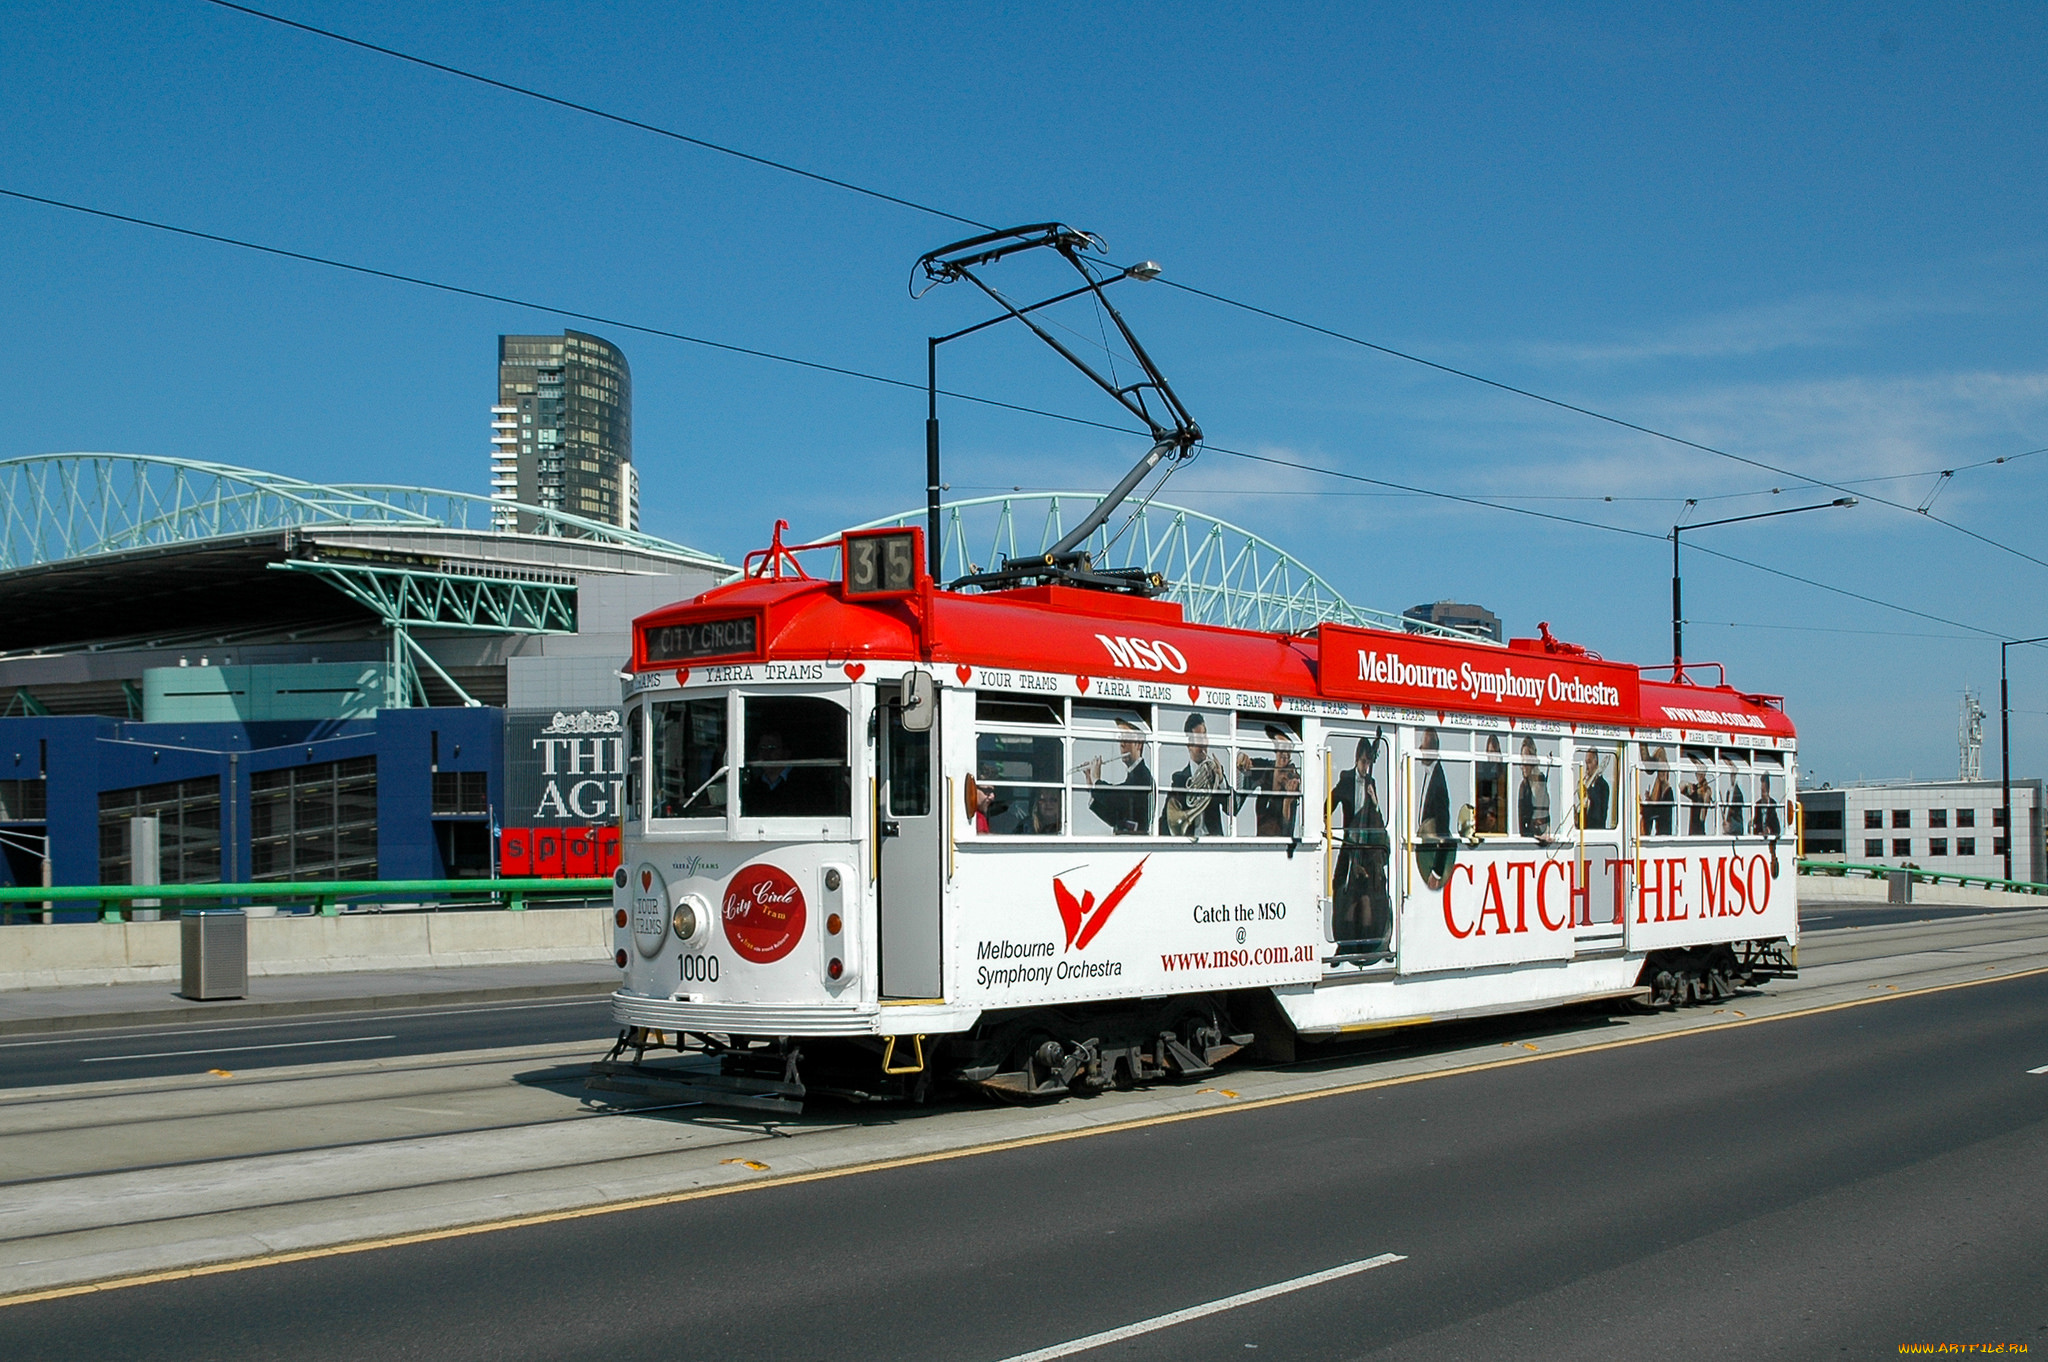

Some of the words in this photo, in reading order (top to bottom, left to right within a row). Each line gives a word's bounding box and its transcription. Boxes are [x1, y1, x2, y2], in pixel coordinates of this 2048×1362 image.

[853, 538, 912, 586] 35
[660, 627, 695, 653] CITY
[700, 618, 751, 648] CIRCLE
[1095, 633, 1188, 674] MSO
[705, 665, 754, 683] YARRA
[764, 664, 823, 681] TRAMS
[979, 671, 1012, 689] YOUR
[1019, 674, 1058, 692] TRAMS
[1357, 649, 1458, 690] Melbourne
[1460, 661, 1546, 706] Symphony
[1547, 673, 1620, 707] Orchestra
[1096, 680, 1132, 698] YARRA
[1138, 684, 1172, 701] TRAMS
[1205, 690, 1231, 706] YOUR
[1236, 693, 1267, 709] TRAMS
[1288, 698, 1317, 713] YARRA
[1322, 701, 1349, 716] TRAMS
[1375, 706, 1397, 720] YOUR
[1401, 708, 1426, 722] TRAMS
[1660, 706, 1767, 729] www.mso.com.au
[637, 898, 659, 915] YOUR
[722, 893, 751, 920] City
[752, 880, 798, 905] Circle
[1442, 858, 1593, 940] CATCH
[1604, 856, 1689, 925] THE
[1699, 853, 1772, 919] MSO
[762, 904, 786, 920] Tram
[1193, 904, 1232, 923] Catch
[1234, 903, 1254, 922] the
[1258, 902, 1287, 920] MSO
[635, 918, 663, 935] TRAMS
[1235, 926, 1247, 944] @
[976, 940, 1055, 961] Melbourne
[1161, 944, 1314, 972] www.mso.com.au
[677, 953, 720, 983] 1000
[976, 964, 1053, 990] Symphony
[1057, 958, 1122, 980] Orchestra
